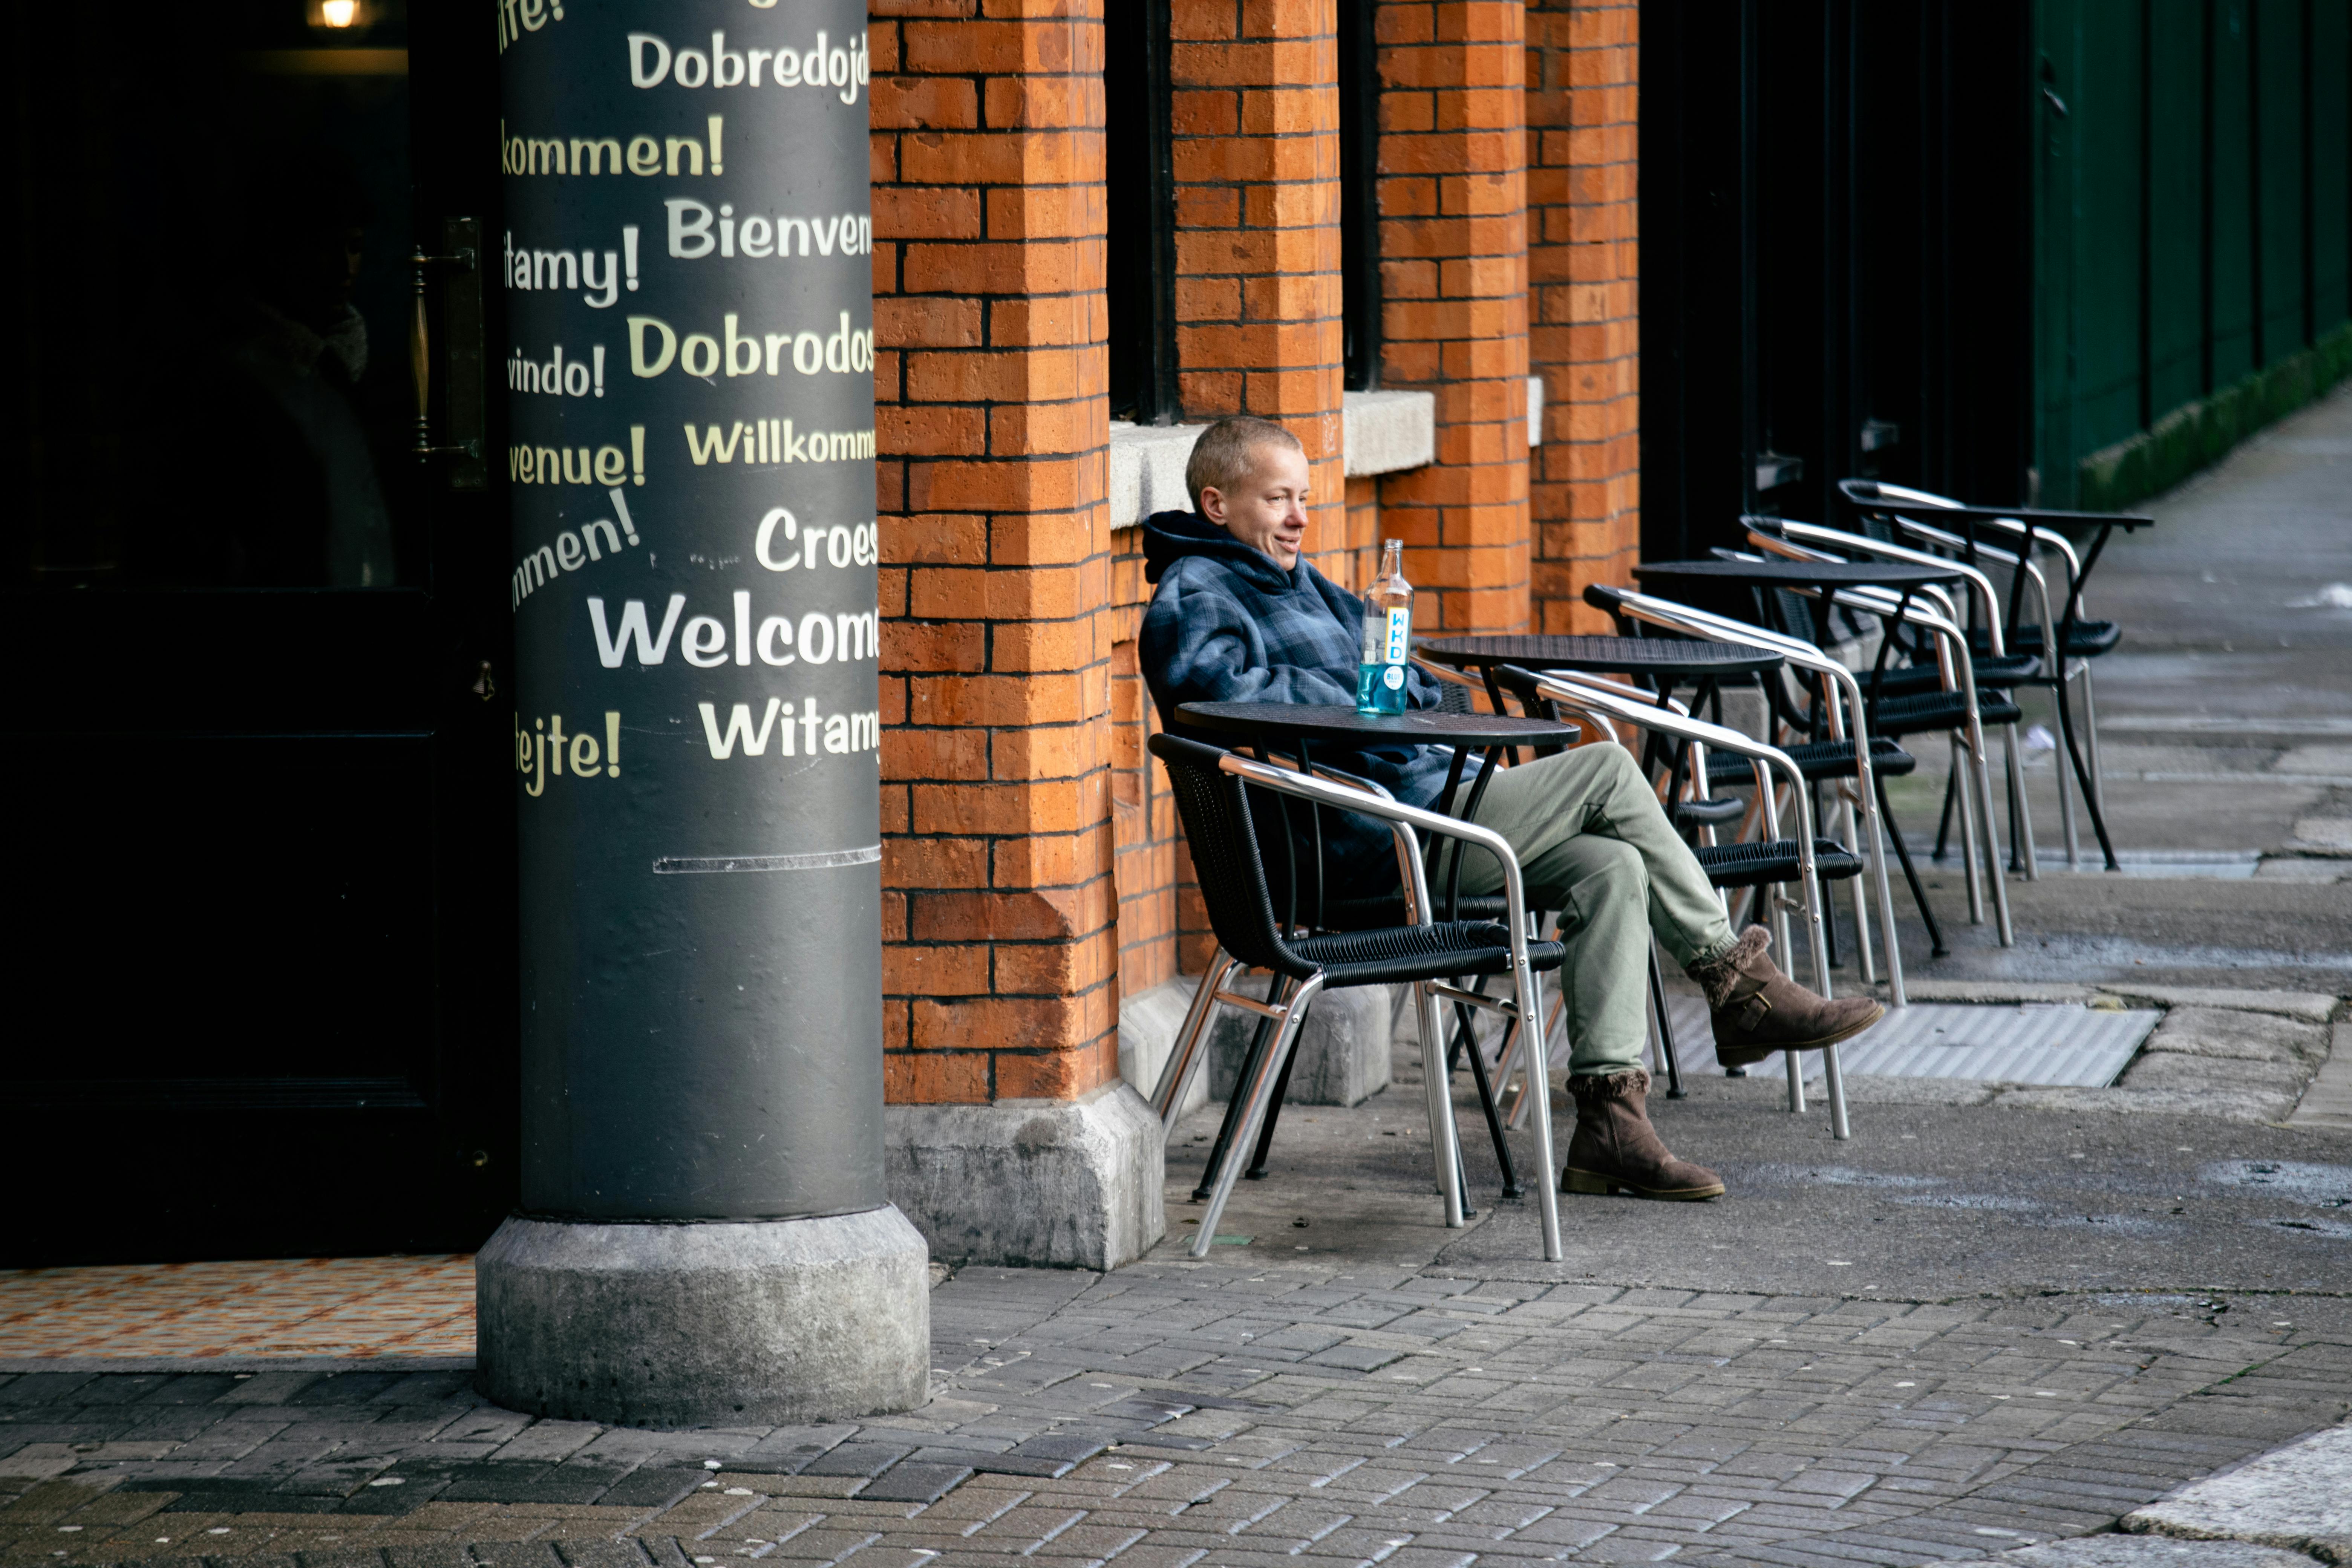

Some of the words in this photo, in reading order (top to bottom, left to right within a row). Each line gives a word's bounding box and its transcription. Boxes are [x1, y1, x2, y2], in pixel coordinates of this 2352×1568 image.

[627, 30, 869, 105] Dobredojd
[501, 115, 723, 176] kommen!
[664, 198, 872, 259] Bienven
[507, 345, 605, 398] vindo!
[509, 425, 645, 486] venue!
[512, 487, 640, 613] mmen!
[755, 507, 878, 572] Croes
[1390, 614, 1404, 658] WKD
